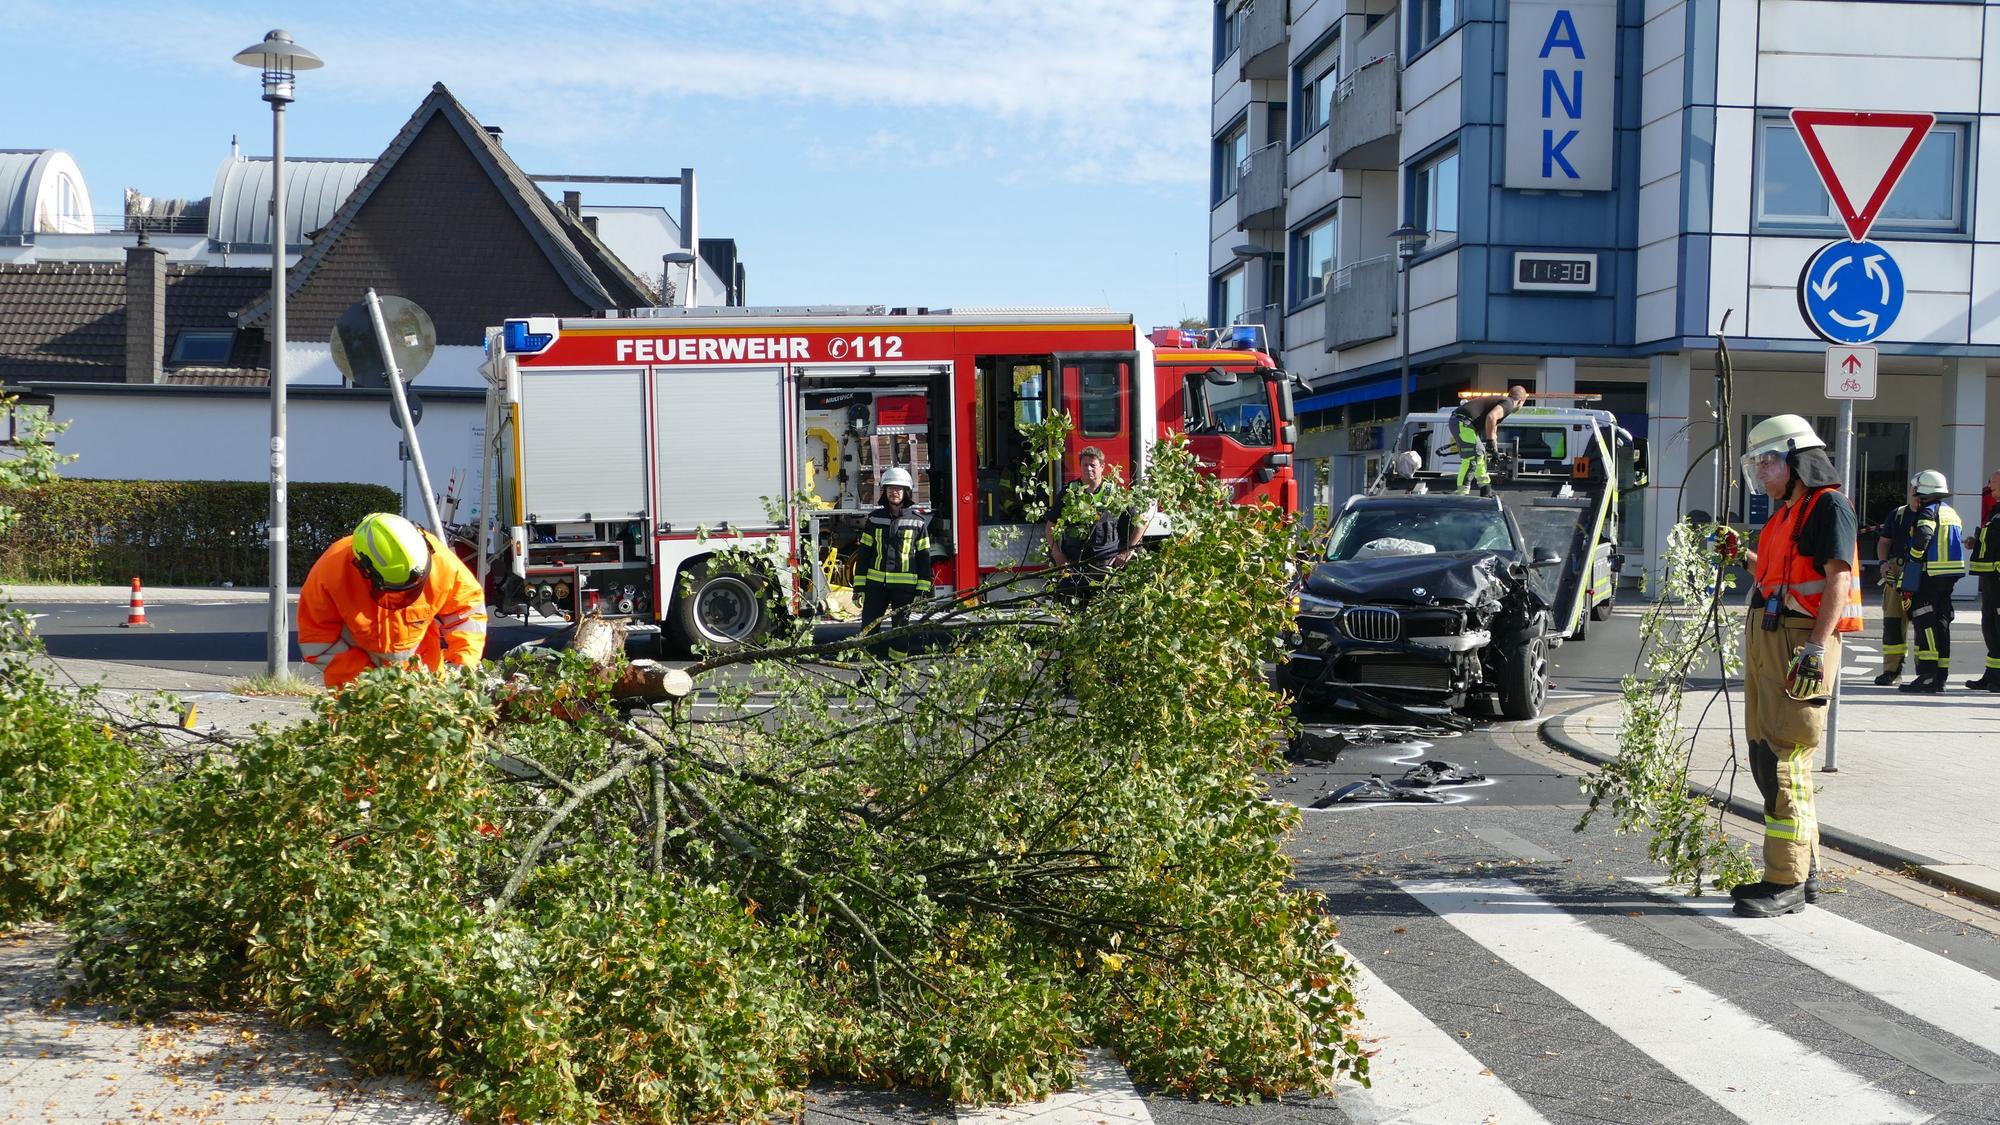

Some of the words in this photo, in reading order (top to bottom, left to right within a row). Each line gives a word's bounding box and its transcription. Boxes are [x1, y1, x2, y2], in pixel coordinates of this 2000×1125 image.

[1538, 10, 1586, 179] ANK
[1532, 263, 1586, 281] 11:38
[616, 338, 810, 361] FEUERWEHR
[850, 336, 903, 358] 112
